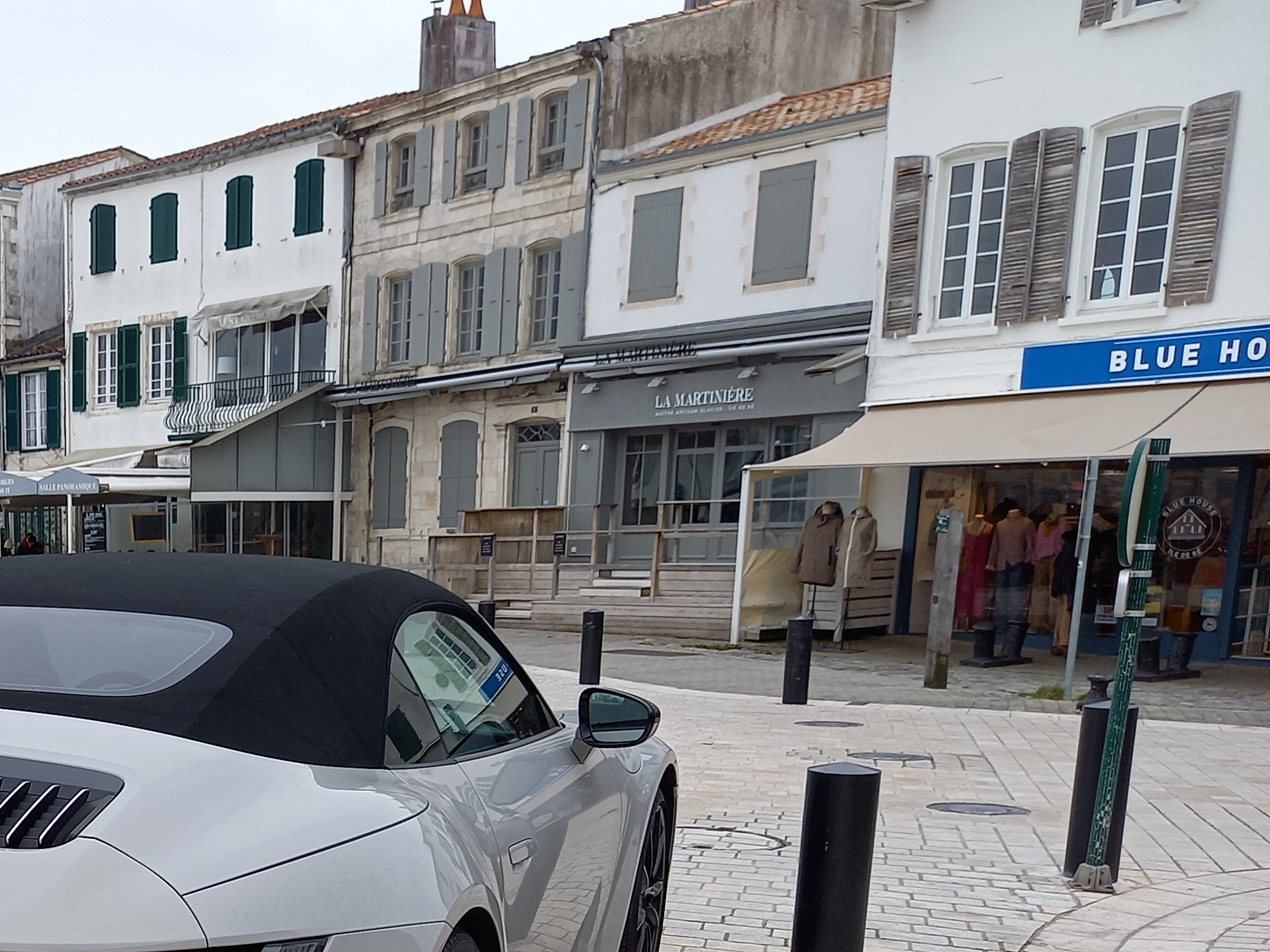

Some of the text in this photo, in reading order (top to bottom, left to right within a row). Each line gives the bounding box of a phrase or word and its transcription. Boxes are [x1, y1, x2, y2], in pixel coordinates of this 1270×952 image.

[1108, 343, 1201, 373] BLUE
[654, 386, 755, 409] LA MARTINIÈRE
[1162, 497, 1218, 517] BLUE HOUSE
